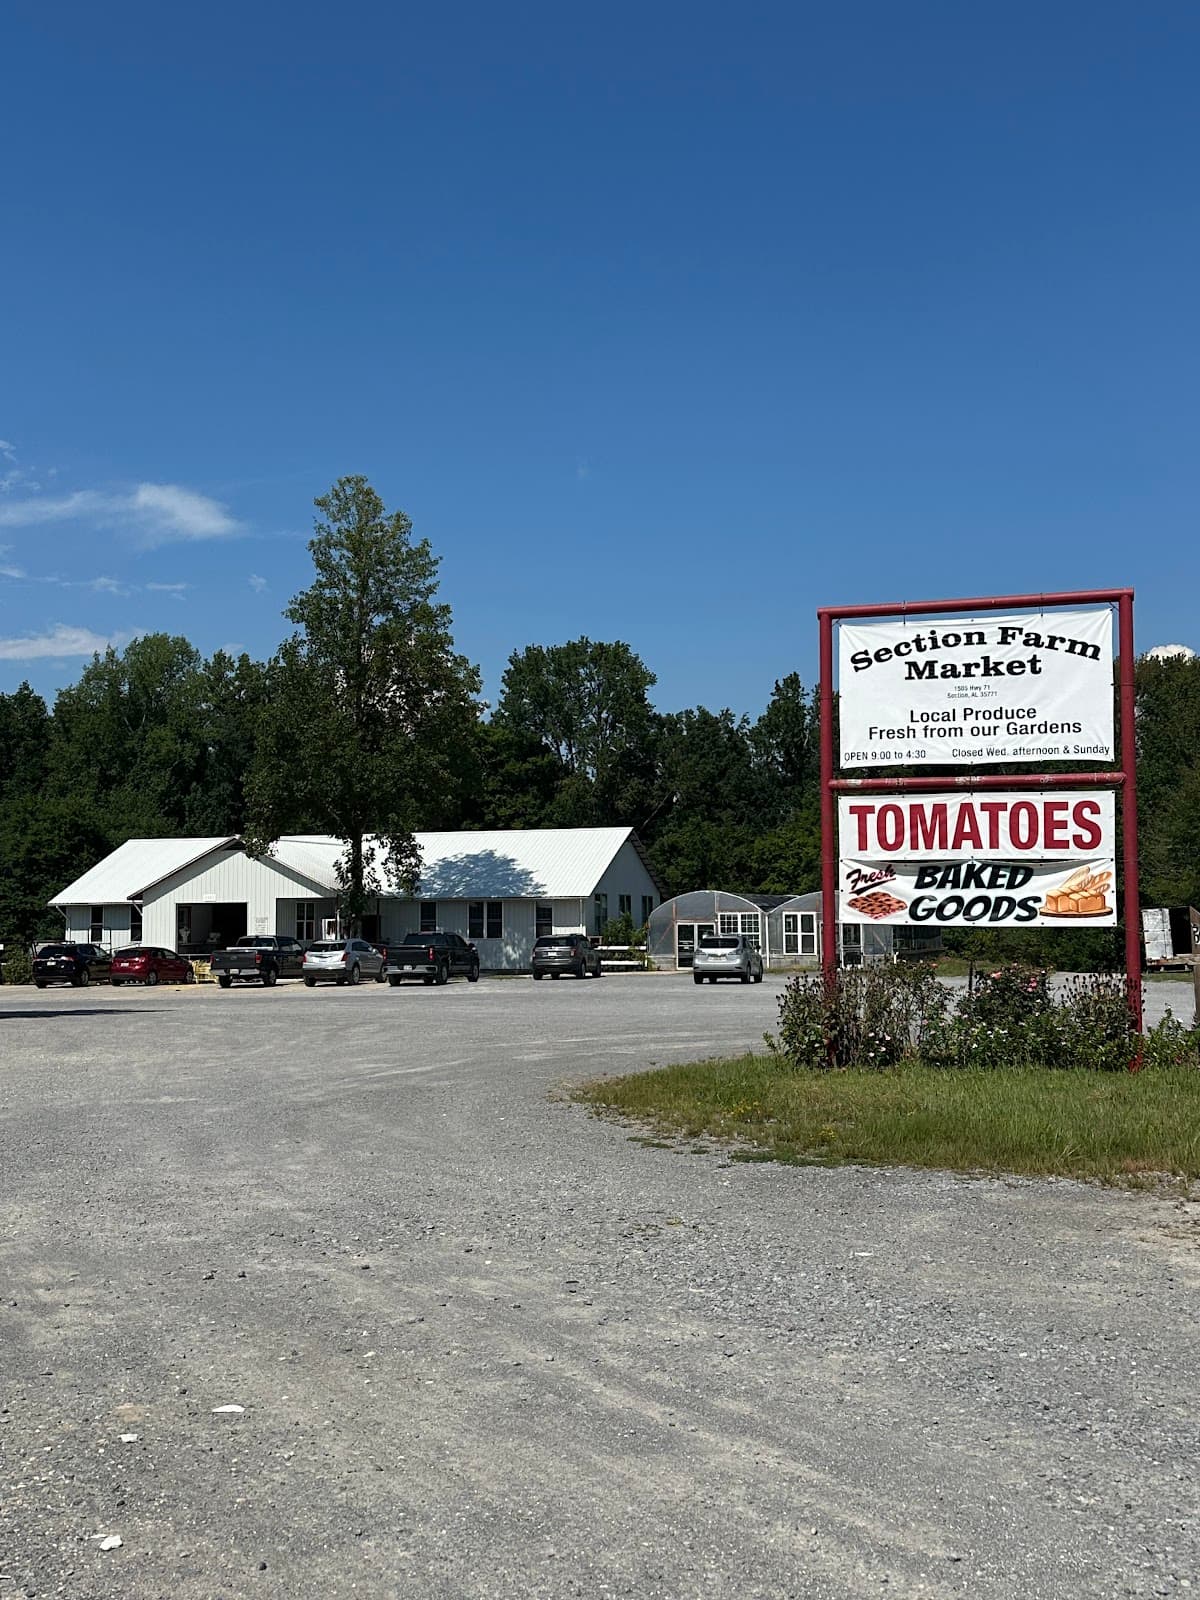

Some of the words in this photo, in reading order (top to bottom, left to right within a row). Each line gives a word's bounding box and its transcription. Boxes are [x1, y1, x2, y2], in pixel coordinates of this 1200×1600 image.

[850, 629, 987, 673] Section
[997, 627, 1101, 661] Farm
[905, 654, 1042, 680] Market
[910, 708, 956, 723] Local
[964, 706, 1037, 721] Produce
[869, 726, 916, 740] Fresh
[923, 725, 963, 739] from
[970, 725, 999, 737] our
[1006, 721, 1082, 736] Gardens
[844, 752, 868, 761] OPEN
[906, 750, 926, 758] 4:30
[952, 748, 982, 757] Closed
[1012, 746, 1059, 755] afternoon
[1063, 746, 1070, 754] &
[1074, 745, 1109, 755] Sunday
[849, 801, 1102, 851] TOMATOES
[846, 864, 896, 890] Fresh
[914, 863, 1034, 890] BAKED
[908, 895, 1043, 922] GOODS
